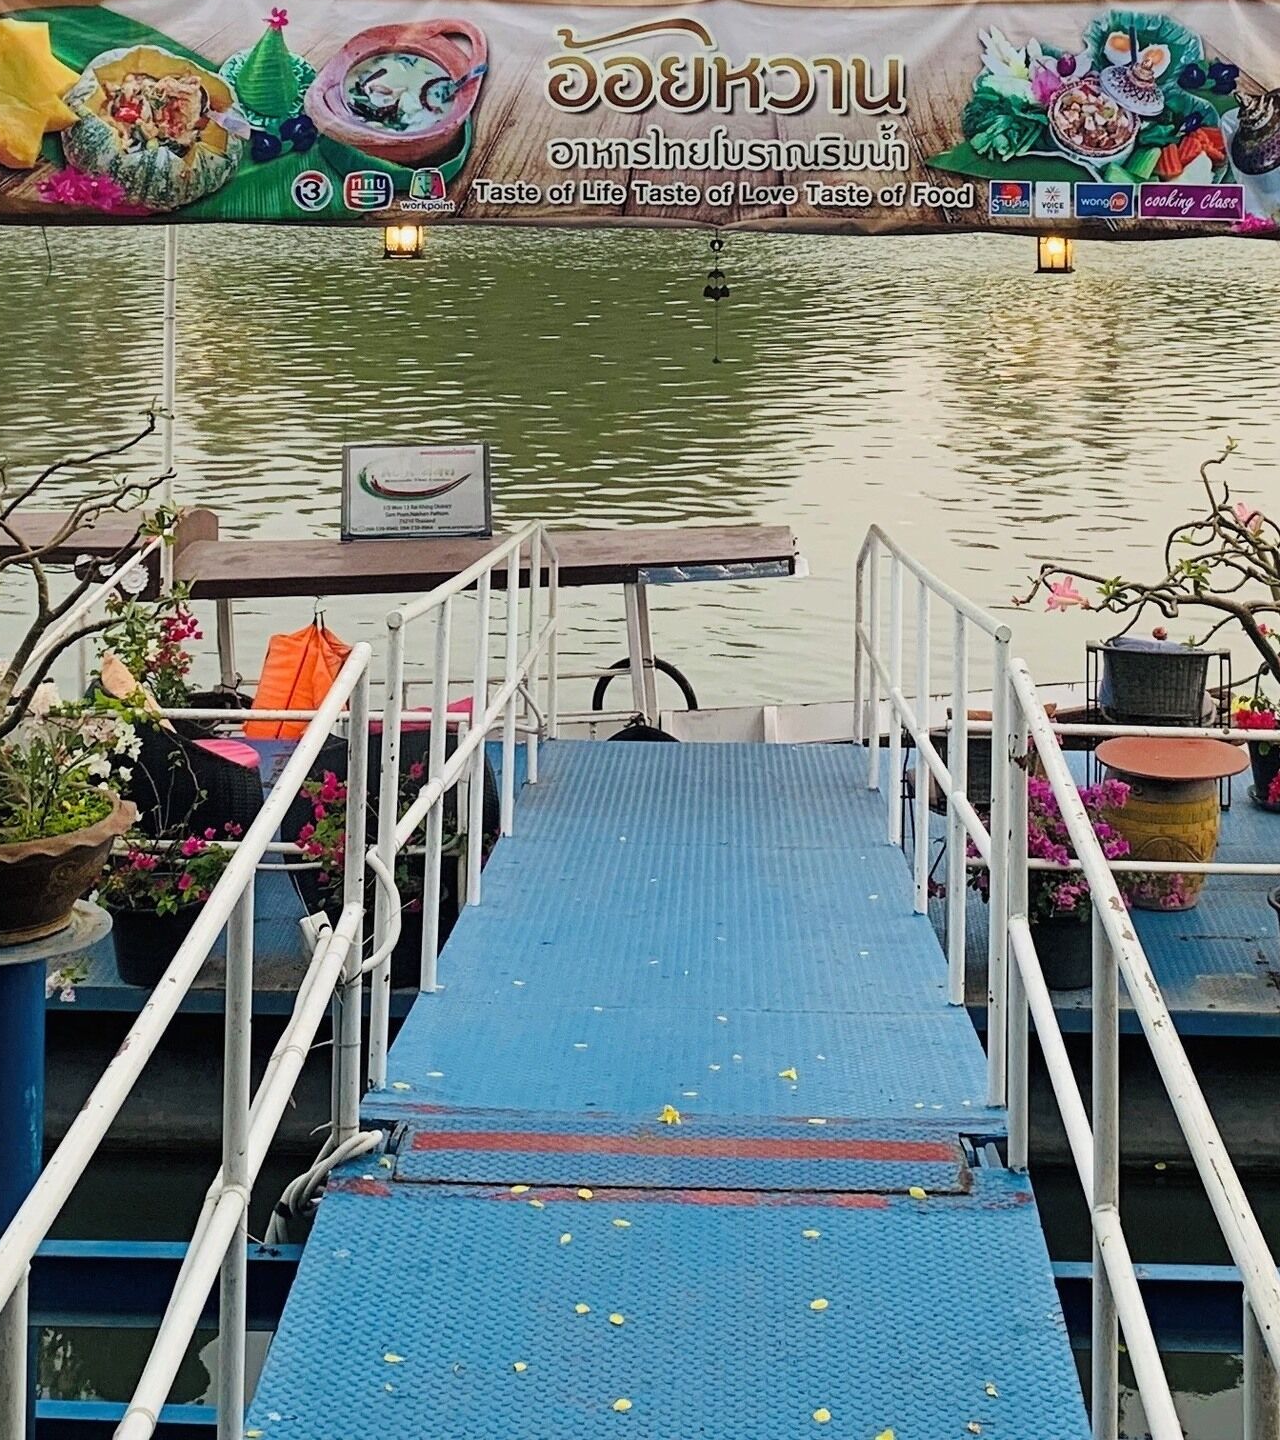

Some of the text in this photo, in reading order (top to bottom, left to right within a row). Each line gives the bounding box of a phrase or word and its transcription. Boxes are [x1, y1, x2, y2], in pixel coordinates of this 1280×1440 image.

[547, 17, 906, 112] อ้อยหวาน
[551, 123, 906, 167] อาหารไทยโบราณริมน้ำ
[402, 201, 453, 211] workpoint
[475, 182, 971, 205] Taste of Life Taste of Love Taste of Food
[1144, 189, 1239, 215] cooking Class
